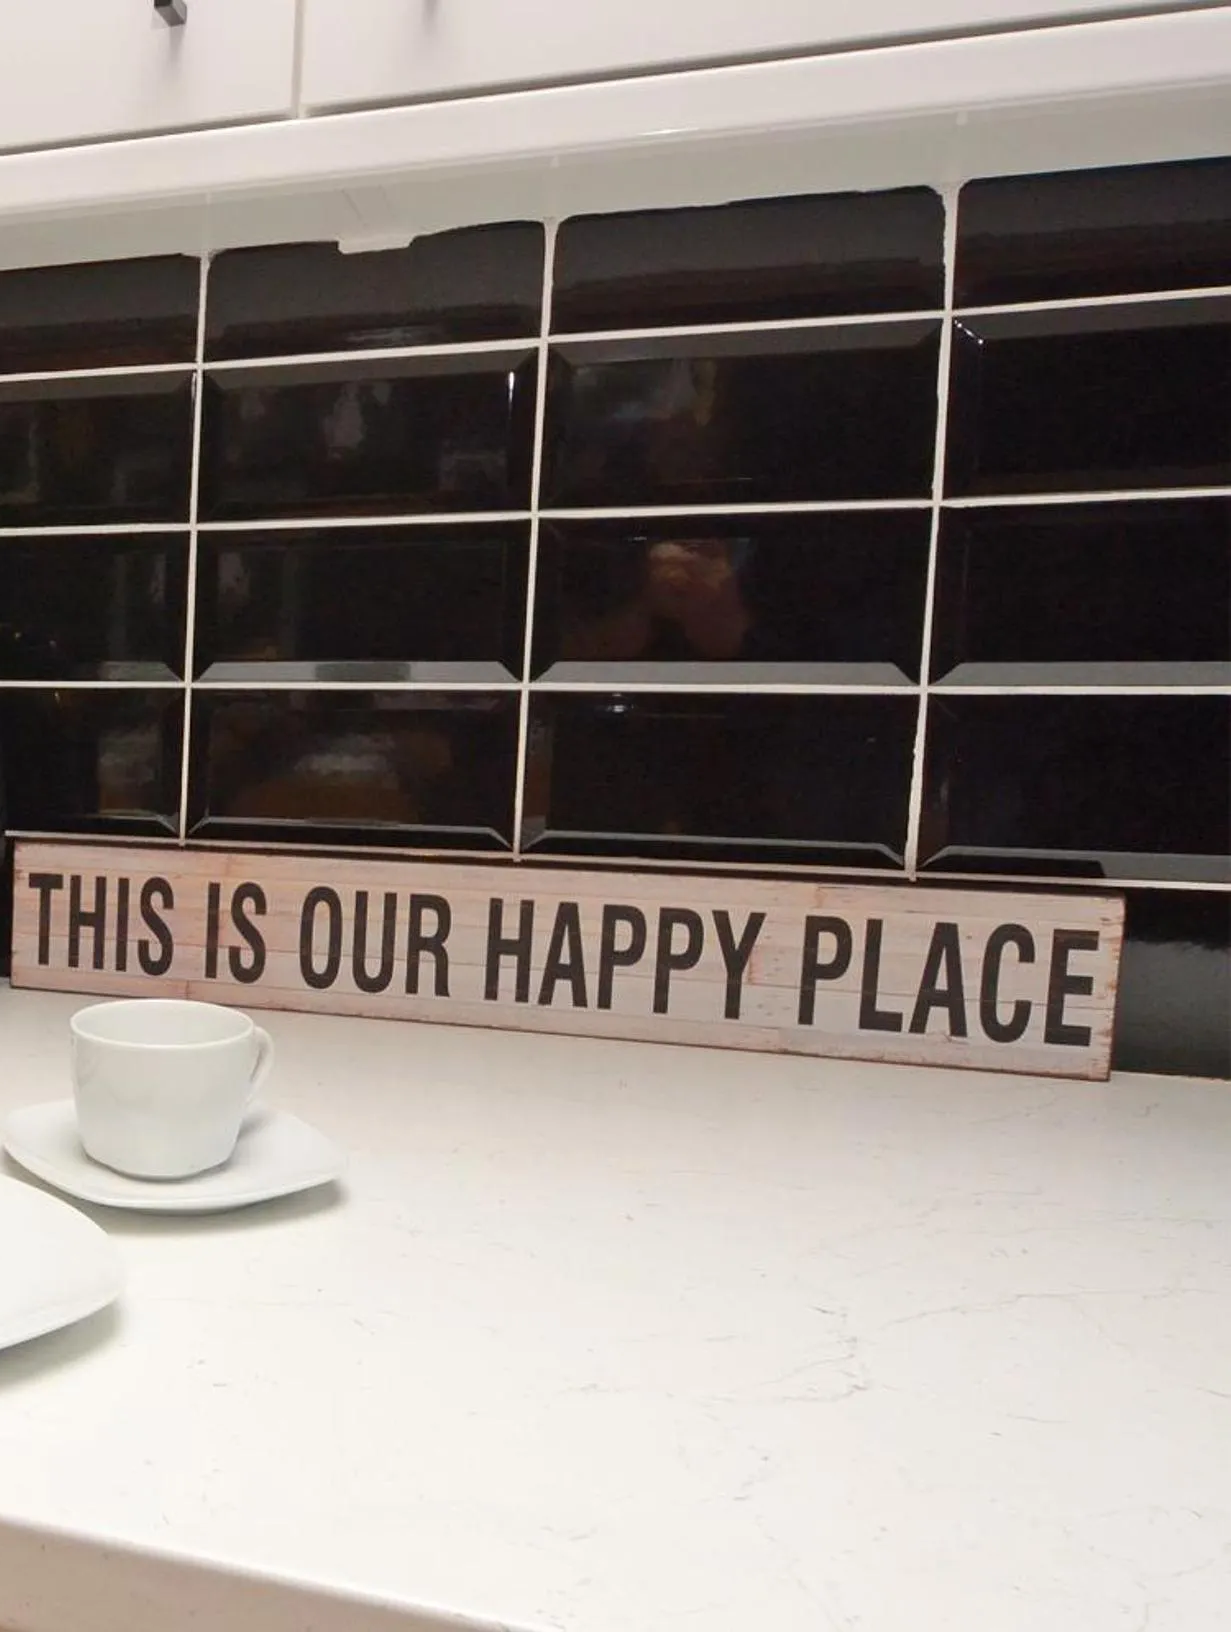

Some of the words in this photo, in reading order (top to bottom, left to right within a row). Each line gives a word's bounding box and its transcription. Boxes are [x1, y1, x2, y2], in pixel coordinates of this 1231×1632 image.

[28, 872, 174, 977] THIS
[204, 881, 267, 984] IS
[299, 886, 452, 998] OUR
[484, 896, 767, 1020] HAPPY
[797, 915, 1100, 1047] PLACE
